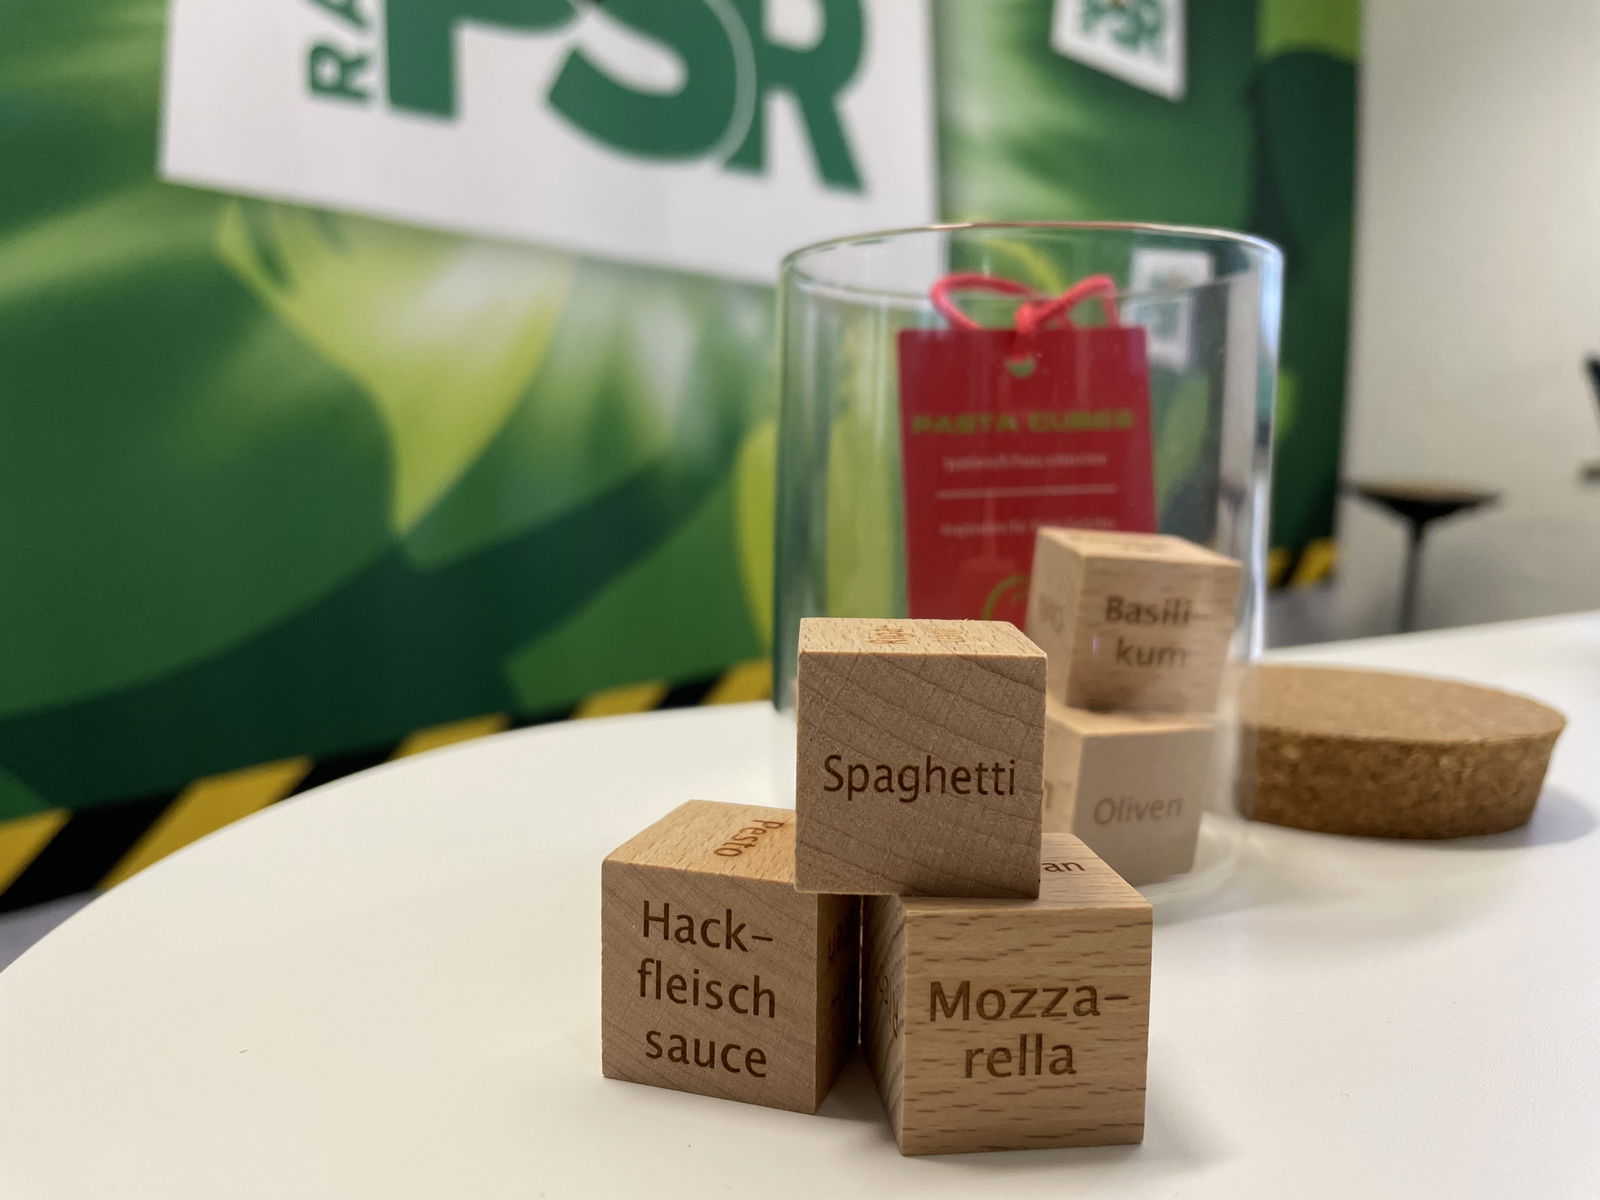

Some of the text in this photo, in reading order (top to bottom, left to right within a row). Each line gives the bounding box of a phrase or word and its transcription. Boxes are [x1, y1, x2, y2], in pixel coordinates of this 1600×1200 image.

[1115, 637, 1188, 668] kum
[823, 754, 1016, 803] Spaghetti
[1093, 797, 1184, 824] Oliven
[643, 899, 774, 952] Hack-
[637, 957, 776, 1018] fleisch
[929, 980, 1130, 1022] Mozza-
[644, 1030, 768, 1078] sauce
[964, 1032, 1077, 1078] rella
